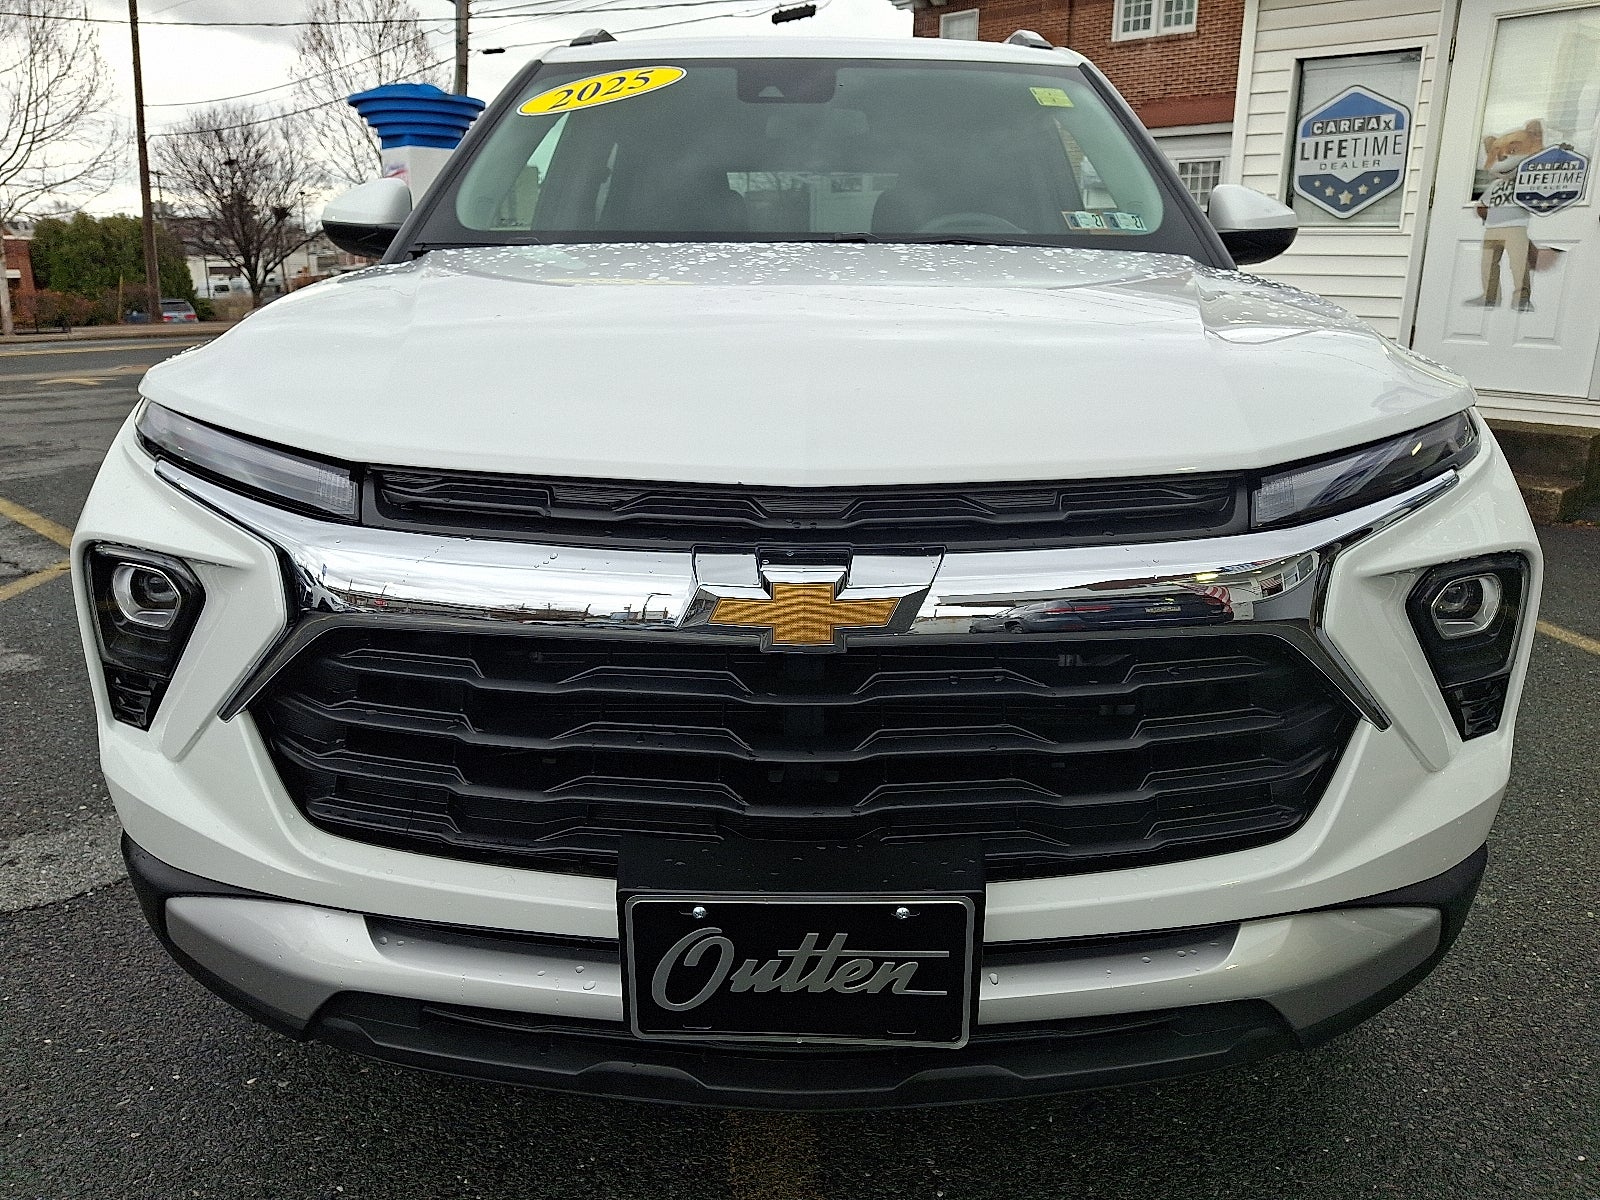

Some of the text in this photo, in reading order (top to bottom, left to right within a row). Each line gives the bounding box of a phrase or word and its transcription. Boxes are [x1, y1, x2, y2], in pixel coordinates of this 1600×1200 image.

[547, 70, 654, 110] 2025
[1312, 116, 1393, 135] CARFAX
[1301, 134, 1403, 161] LIFETIME
[1320, 159, 1381, 171] DEALER
[1528, 161, 1580, 171] CARFAX
[1519, 171, 1583, 185] LIFETIME
[1489, 192, 1513, 207] FOX
[652, 927, 949, 1011] Outten
